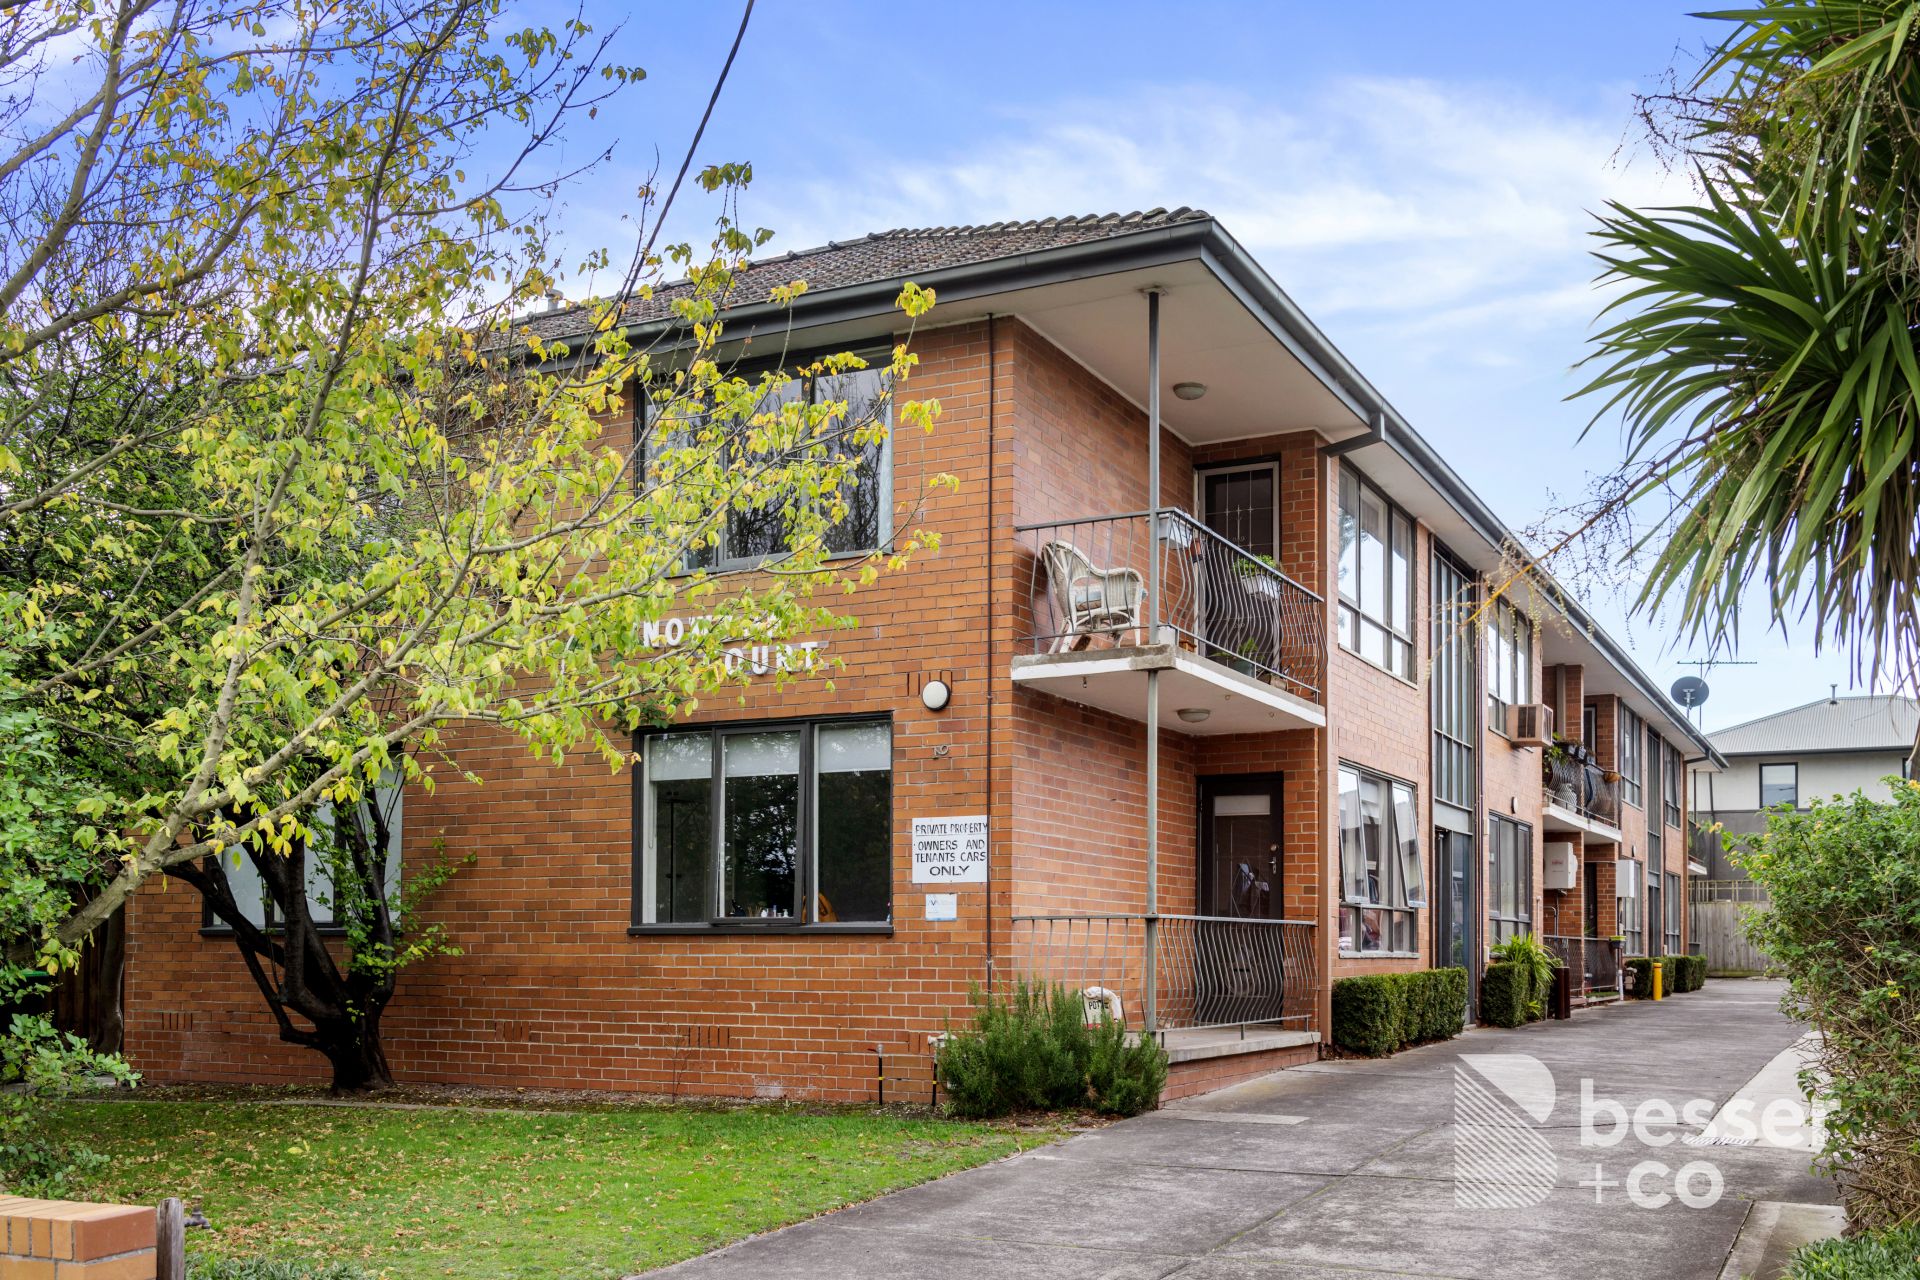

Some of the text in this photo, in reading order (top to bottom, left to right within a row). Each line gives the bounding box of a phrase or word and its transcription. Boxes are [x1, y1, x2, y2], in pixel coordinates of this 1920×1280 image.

[702, 641, 818, 675] OURT
[915, 822, 988, 834] PRIVATE PROPERTY
[917, 839, 985, 851] OWNERS AND
[915, 851, 987, 863] TENANTS CARS
[929, 865, 970, 876] ONLY
